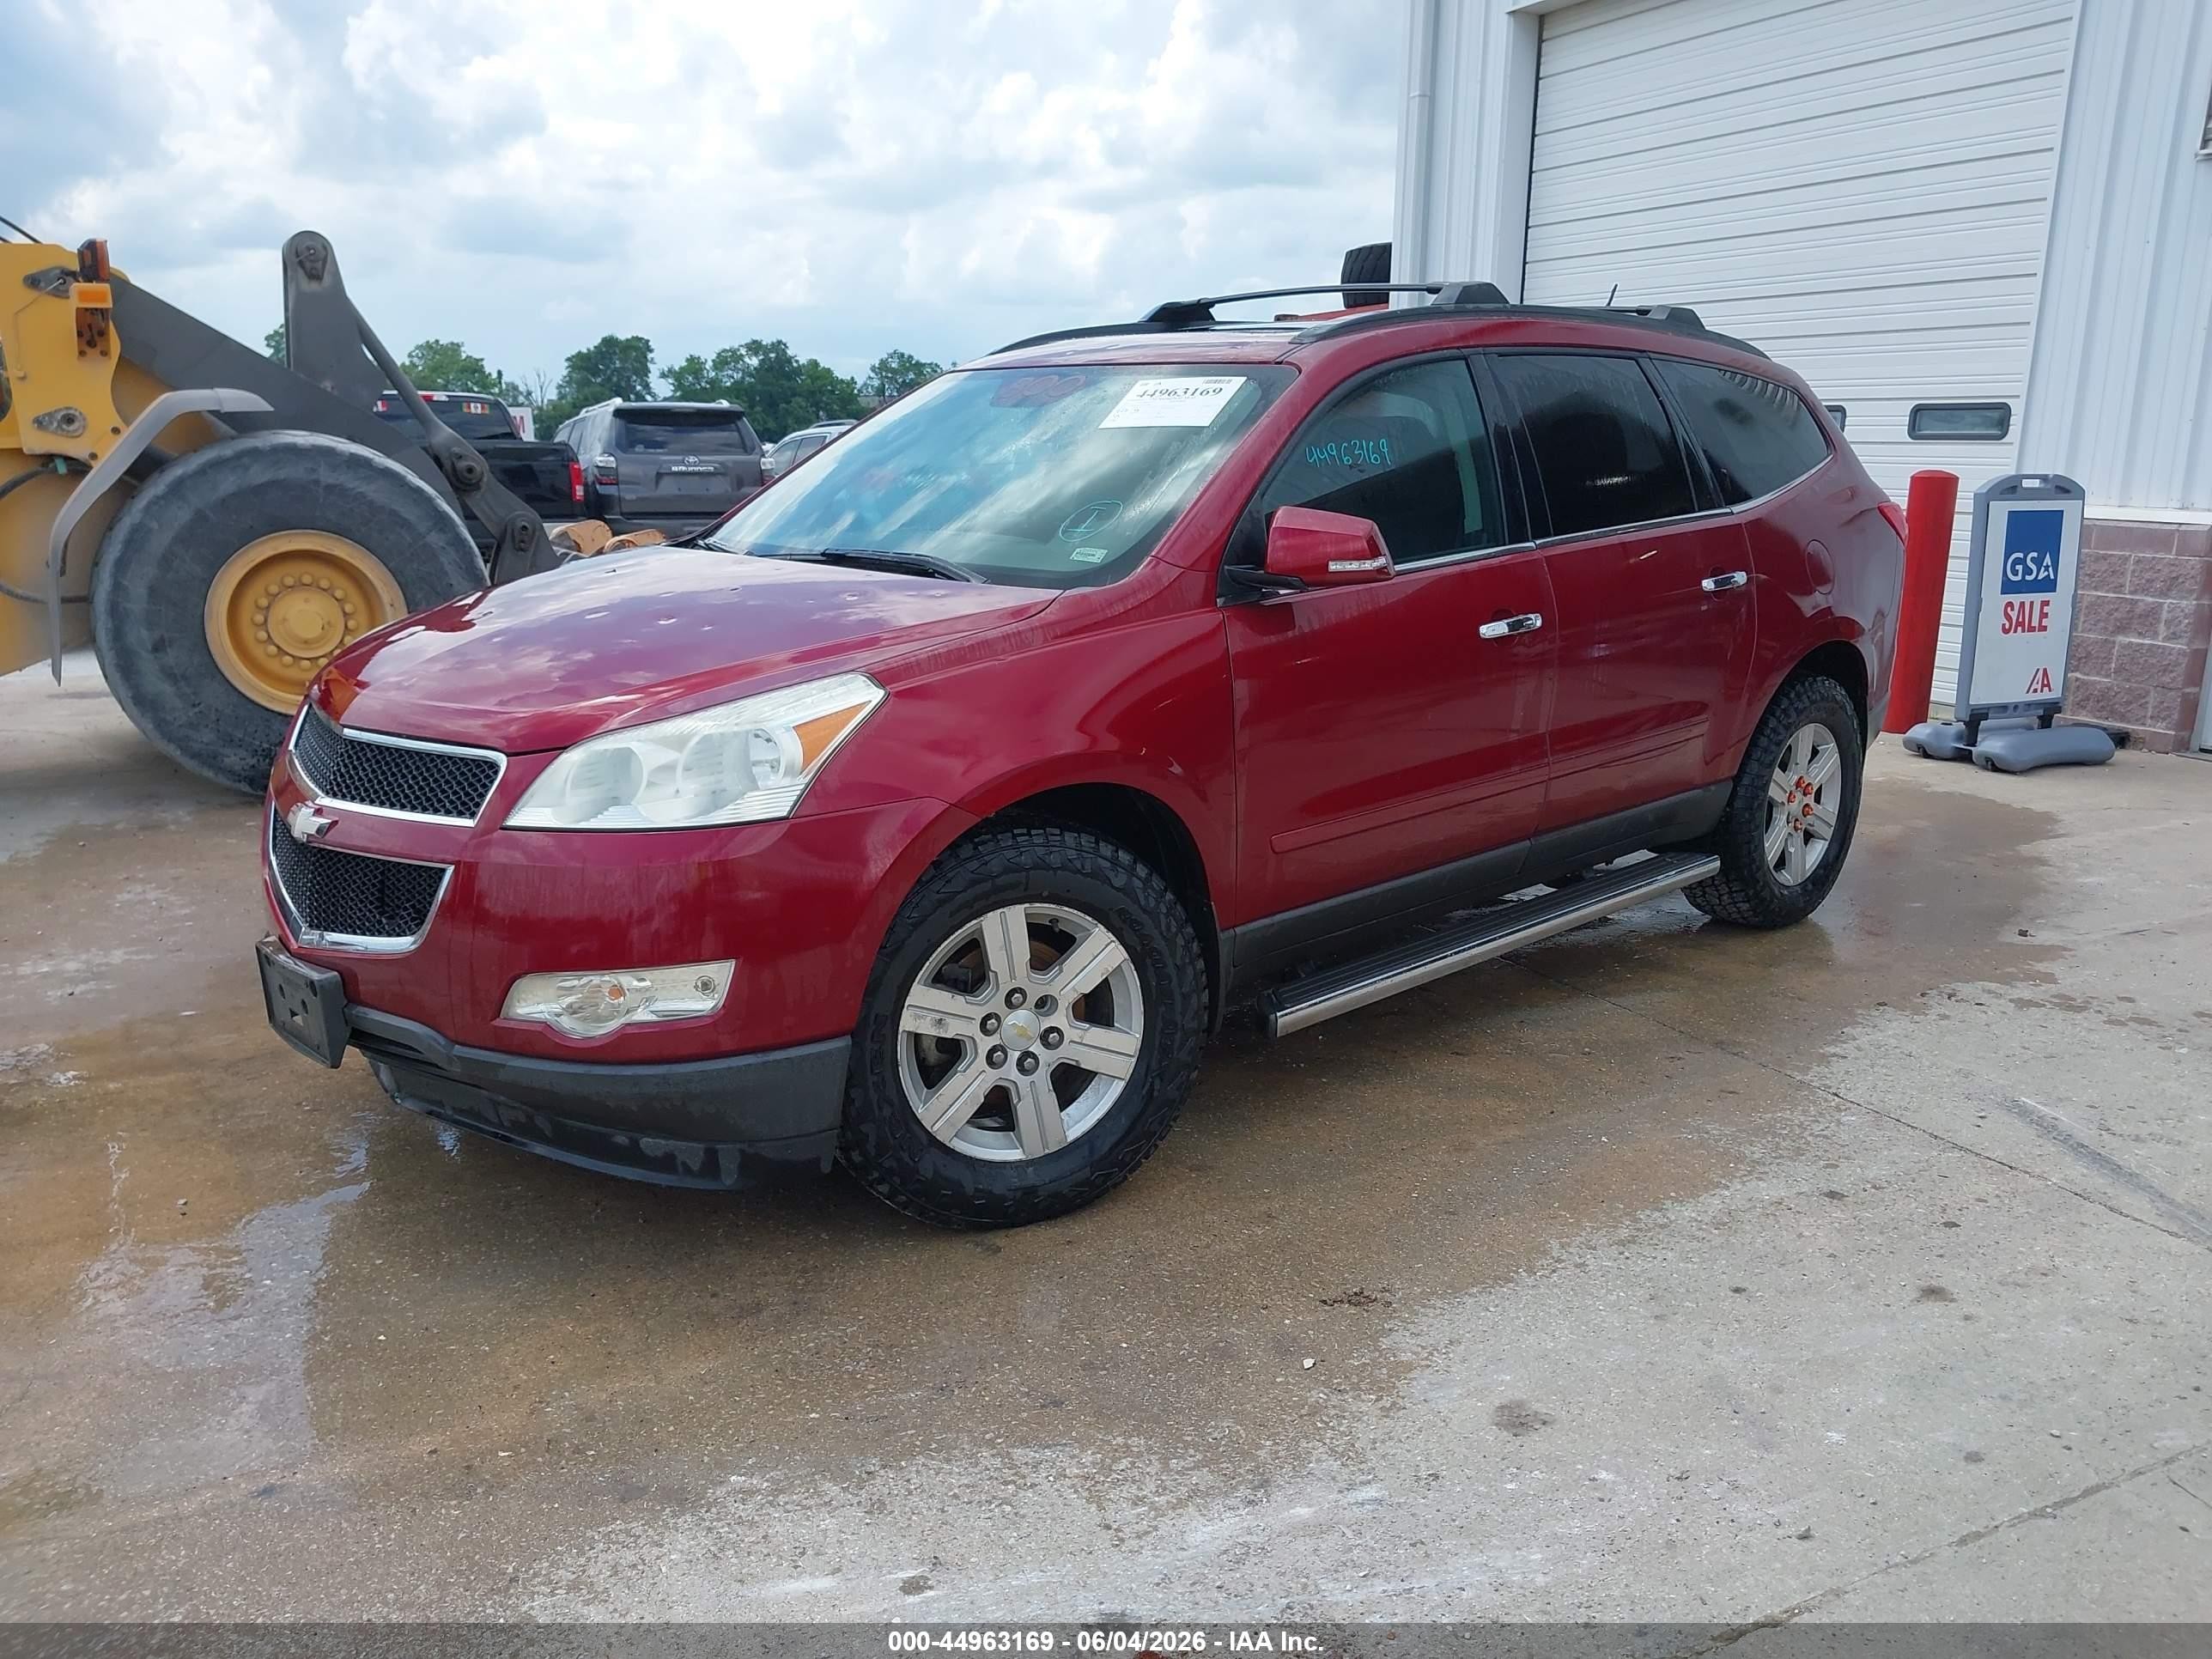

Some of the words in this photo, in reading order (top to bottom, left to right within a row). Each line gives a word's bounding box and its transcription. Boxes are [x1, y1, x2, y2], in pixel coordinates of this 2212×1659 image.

[1136, 386, 1224, 398] 44963169
[1305, 439, 1391, 468] 44963169
[2006, 550, 2055, 581] GSA
[2001, 599, 2051, 635] SALE
